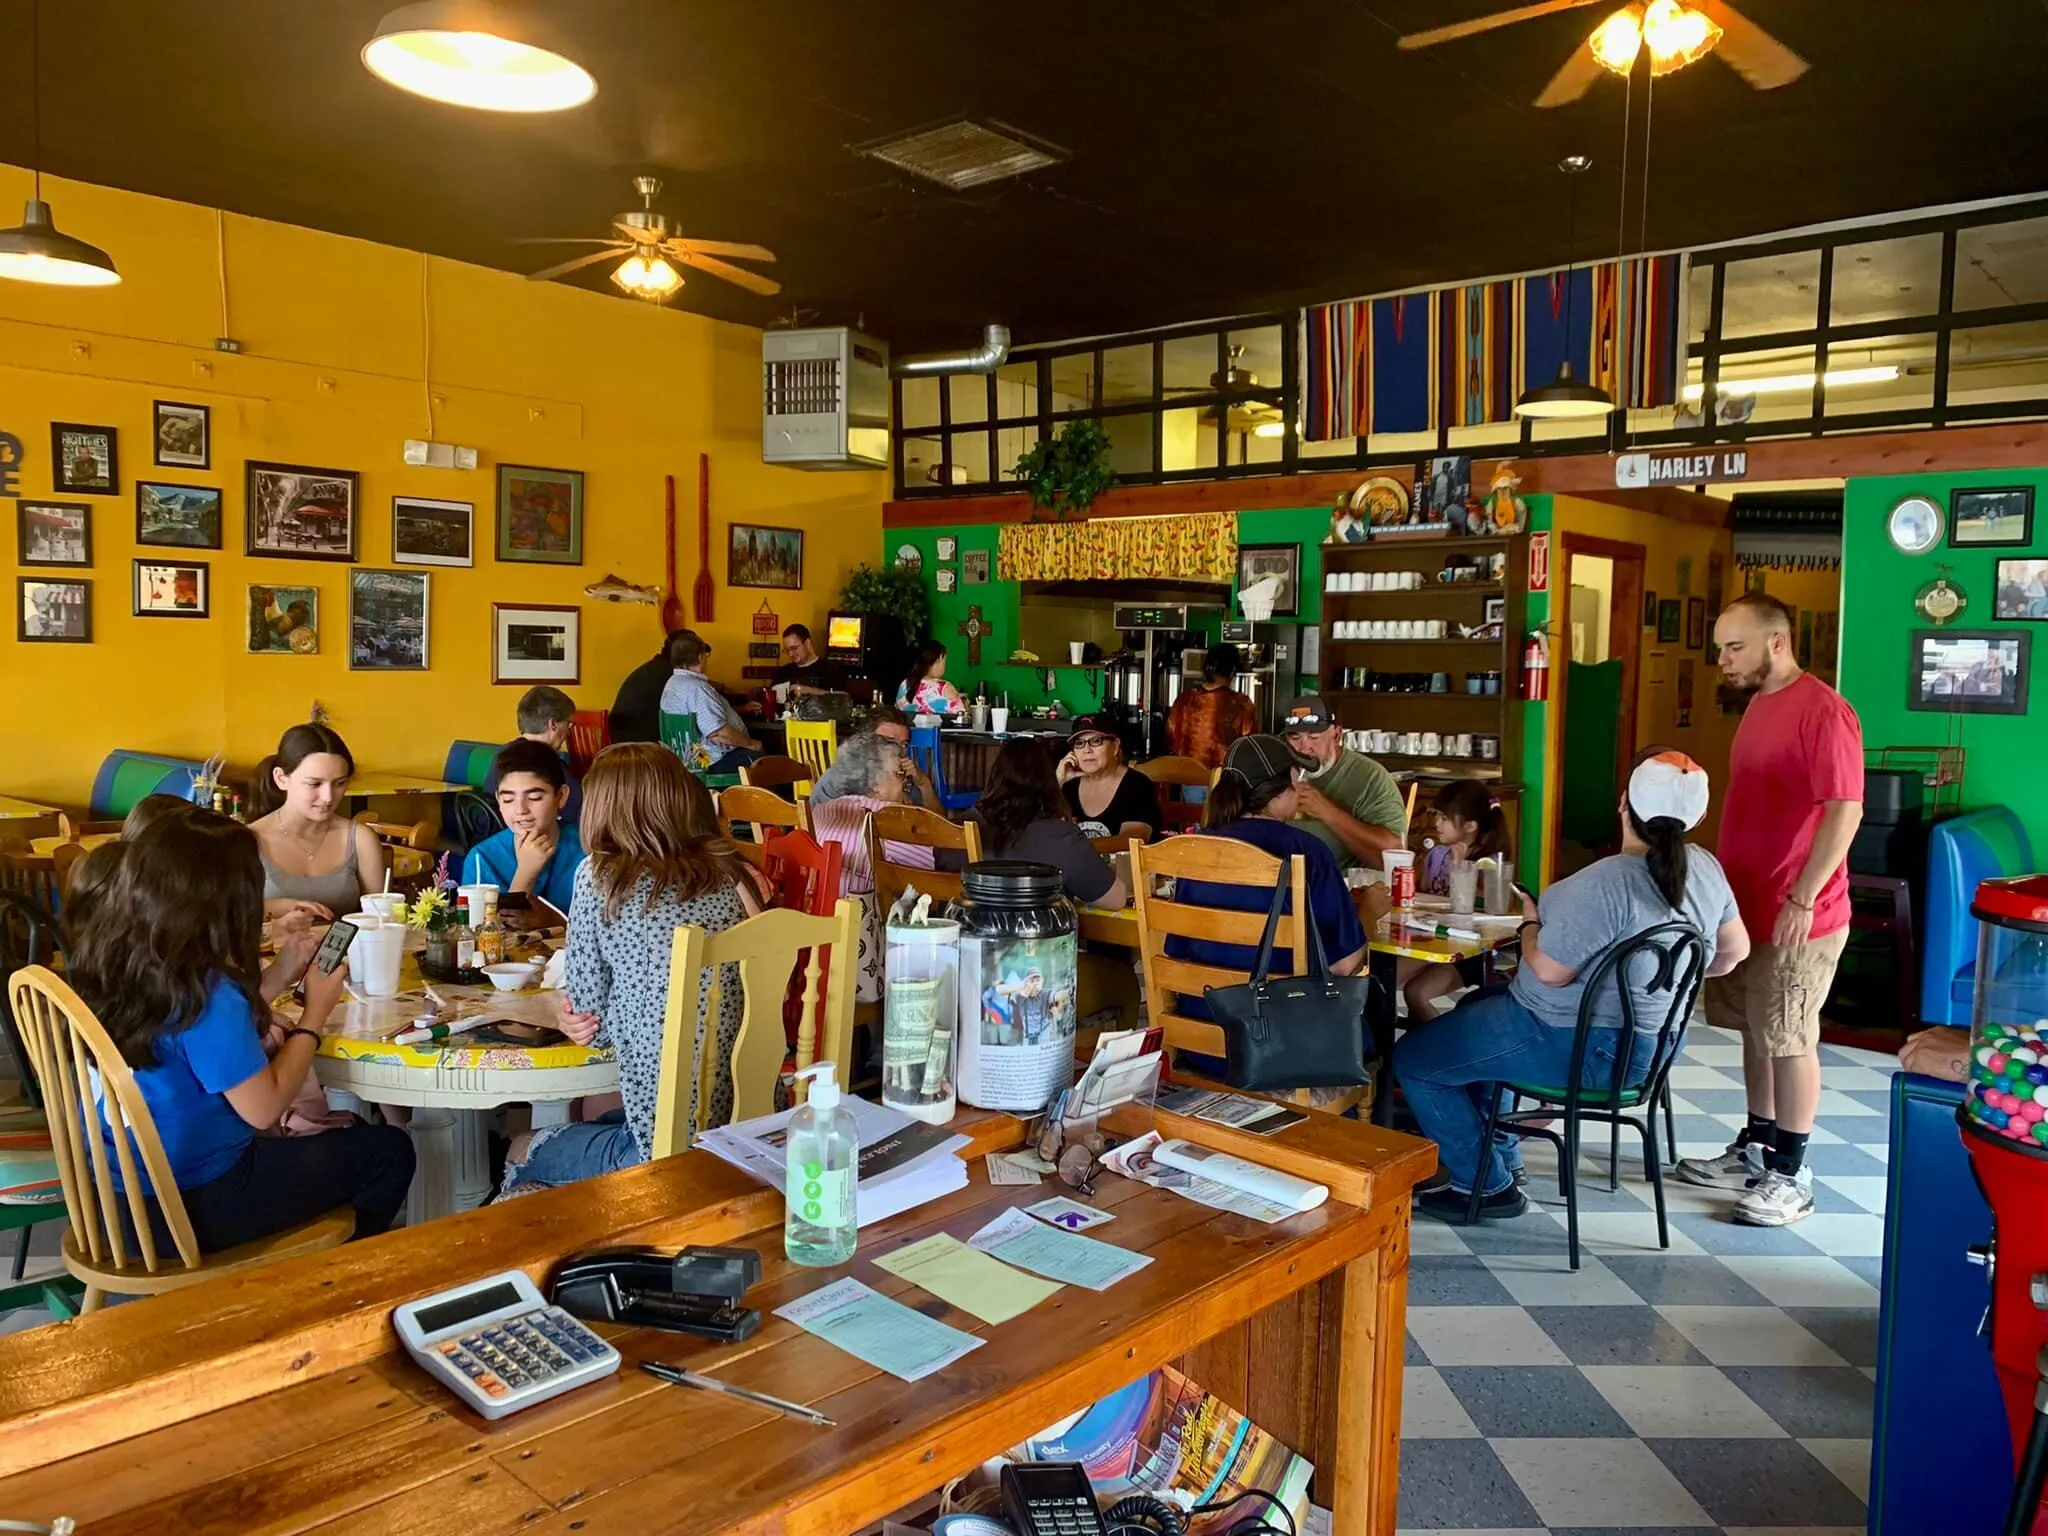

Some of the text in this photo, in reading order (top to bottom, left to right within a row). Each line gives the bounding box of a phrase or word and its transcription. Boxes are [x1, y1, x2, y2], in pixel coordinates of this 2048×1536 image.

[1423, 459, 1433, 487] DEAN
[1649, 453, 1747, 480] HARLEY LN
[1412, 481, 1423, 513] JAMES
[964, 552, 987, 563] COFFEE
[1083, 1440, 1112, 1461] County
